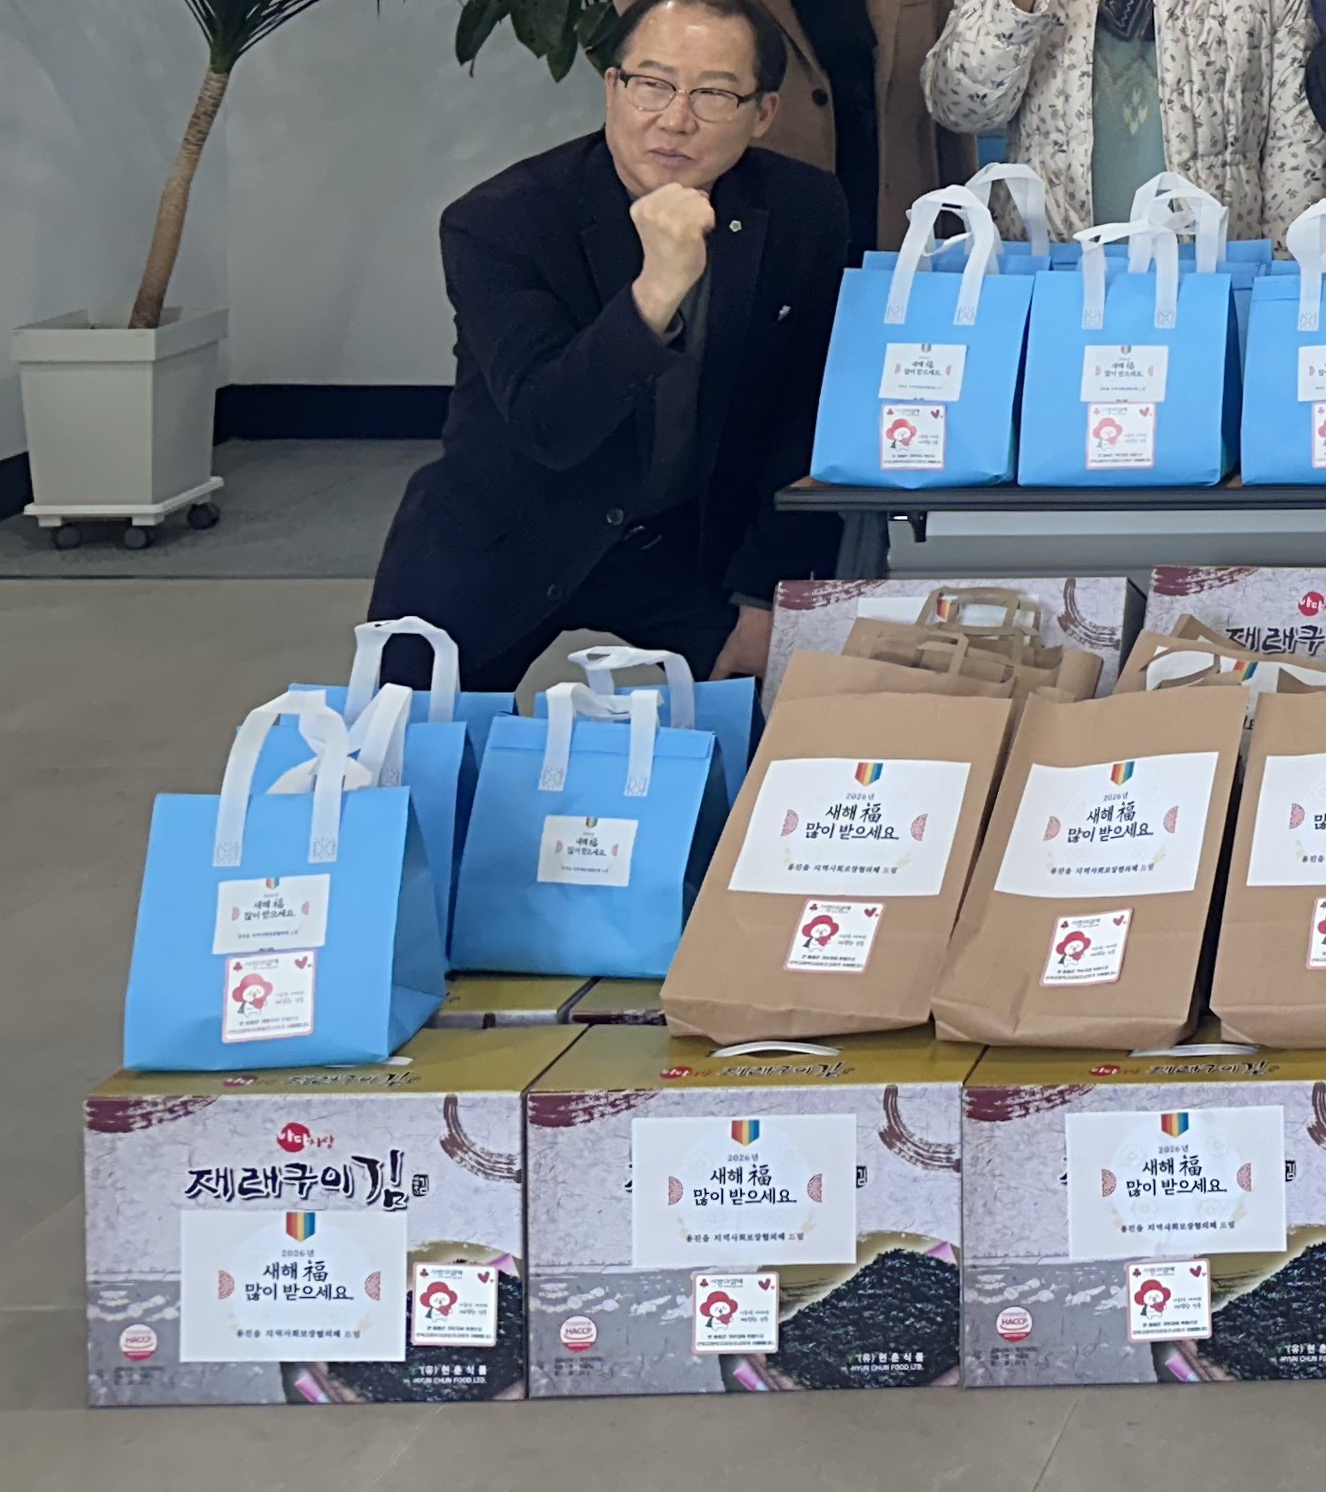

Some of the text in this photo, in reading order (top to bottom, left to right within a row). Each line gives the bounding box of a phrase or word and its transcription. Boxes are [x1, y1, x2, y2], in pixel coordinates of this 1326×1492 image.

[826, 801, 882, 823] 새해 福
[1086, 802, 1136, 824] 새해 福
[805, 822, 900, 841] 많이 받으세요.
[1068, 822, 1154, 843] 많이 받으세요.
[727, 1154, 759, 1162] 2026년
[1158, 1146, 1189, 1154] 2026년
[711, 1165, 771, 1187] 새해 福
[1142, 1155, 1202, 1177] 새해 福
[186, 1150, 408, 1211] 재래구이김
[1125, 1178, 1227, 1197] 많이 받으세요.
[693, 1188, 797, 1207] 많이 받으세요.
[281, 1249, 315, 1258] 2026년
[263, 1260, 328, 1282] 새해 福
[245, 1283, 354, 1302] 많이 받으세요.
